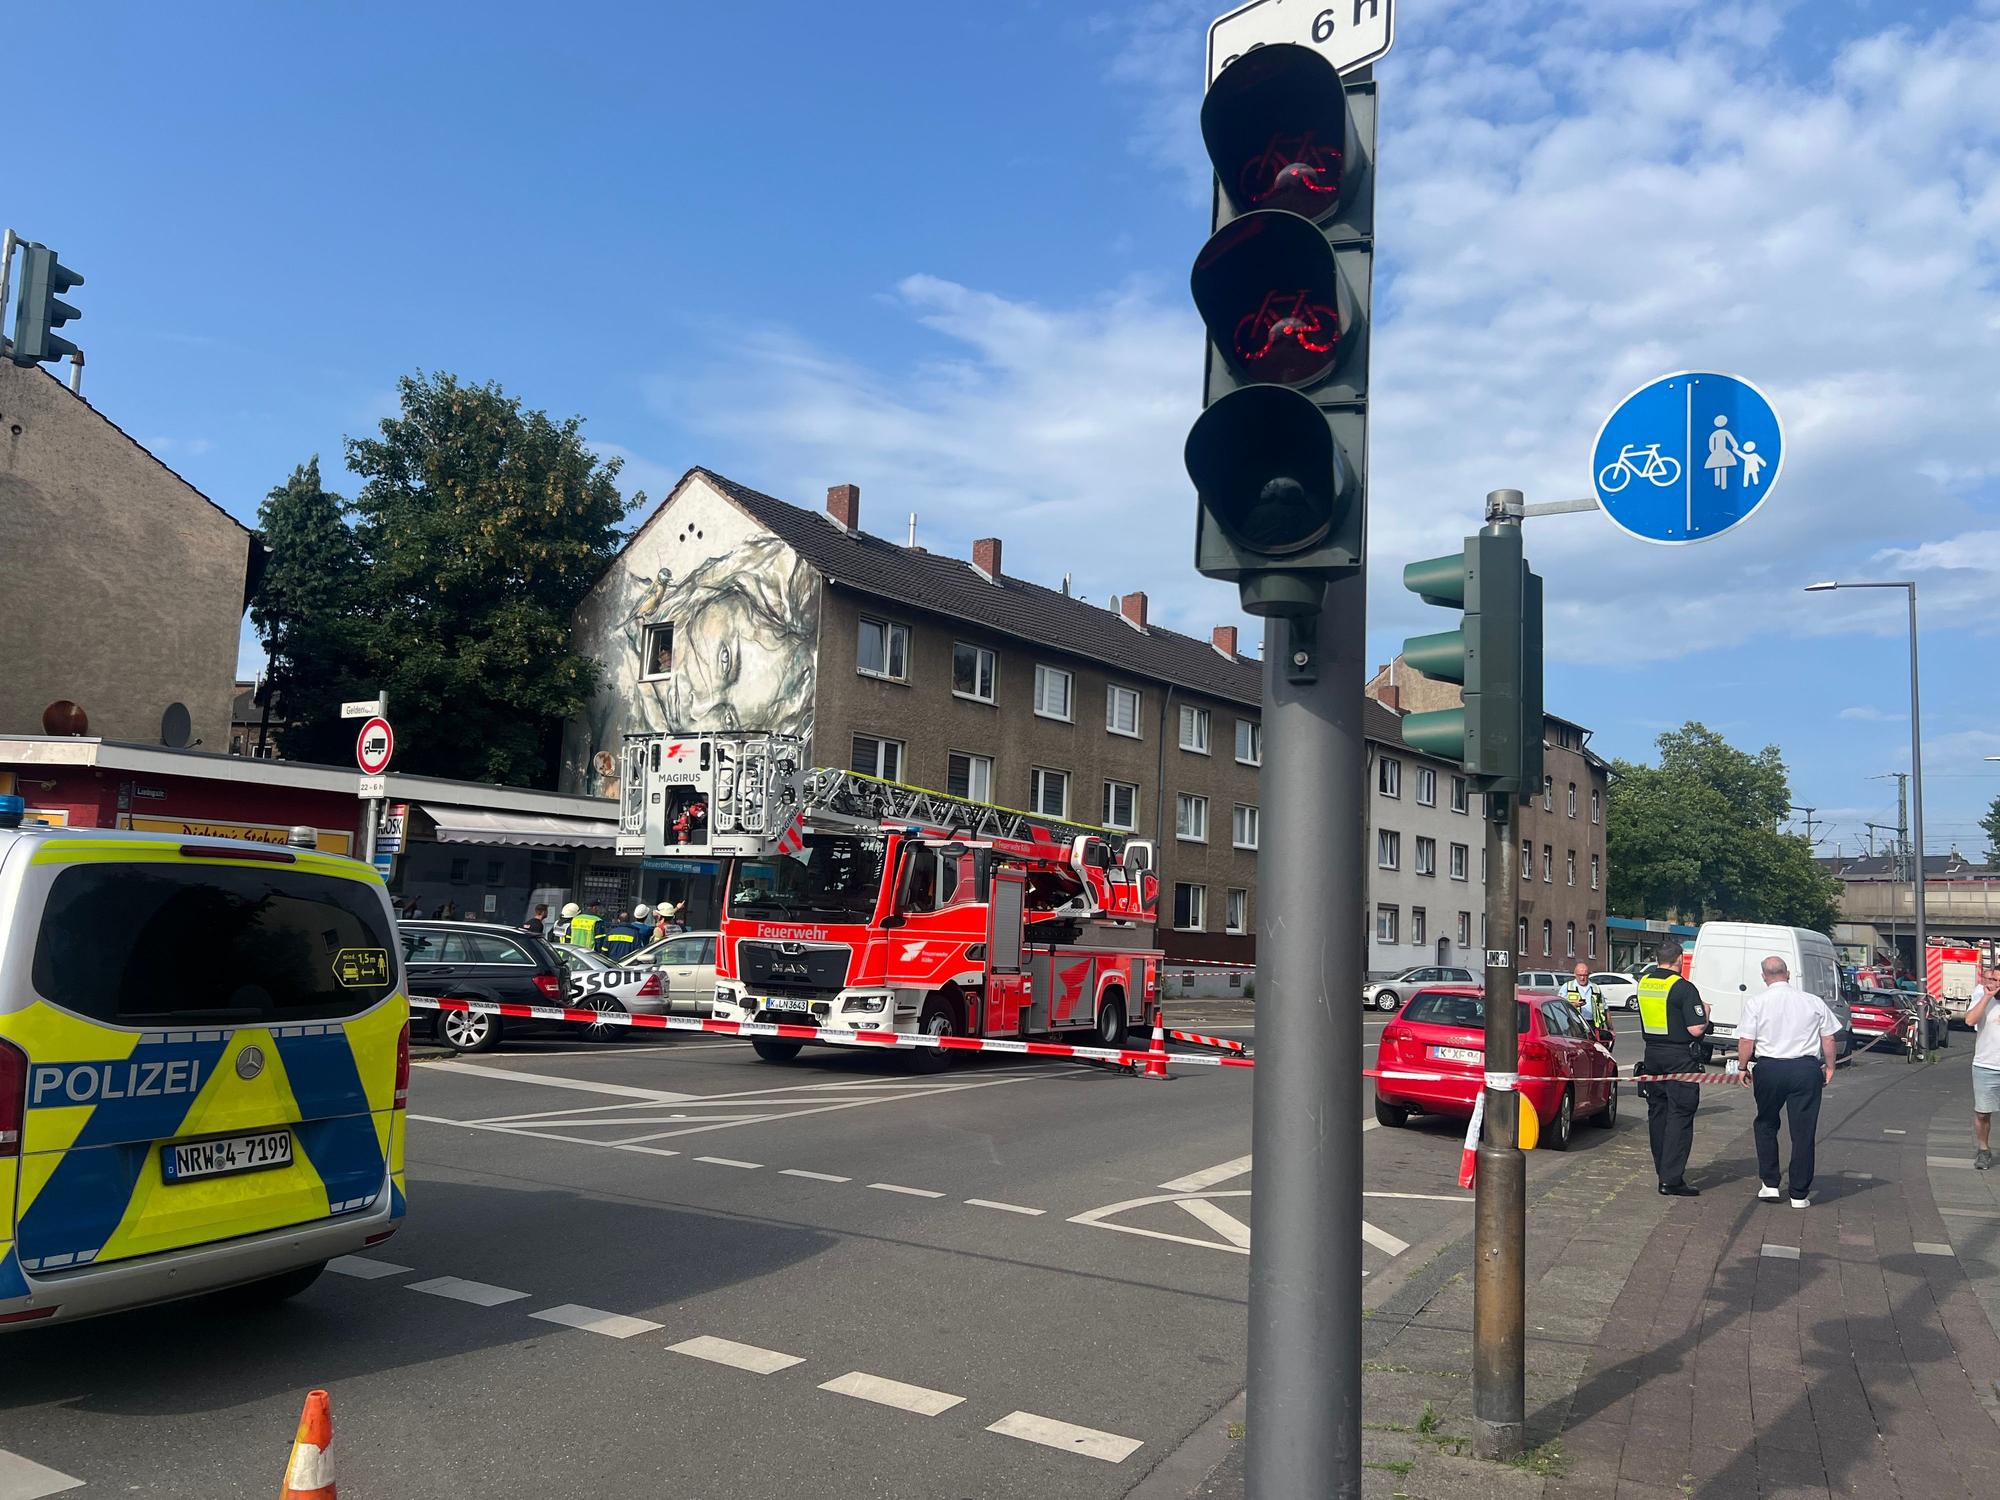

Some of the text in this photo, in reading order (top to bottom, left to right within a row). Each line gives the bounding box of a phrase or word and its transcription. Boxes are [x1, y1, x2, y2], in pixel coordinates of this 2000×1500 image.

[1311, 8, 1335, 44] 6
[360, 783, 369, 791] 22
[373, 783, 378, 791] 6
[378, 783, 384, 791] h
[658, 773, 701, 783] MAGIRUS
[777, 804, 801, 840] MAGIRUS
[757, 923, 829, 940] Feuerwehr
[771, 962, 808, 974] MAN
[33, 1059, 200, 1104] POLIZEI
[168, 1134, 290, 1174] D NRW 4-7199
